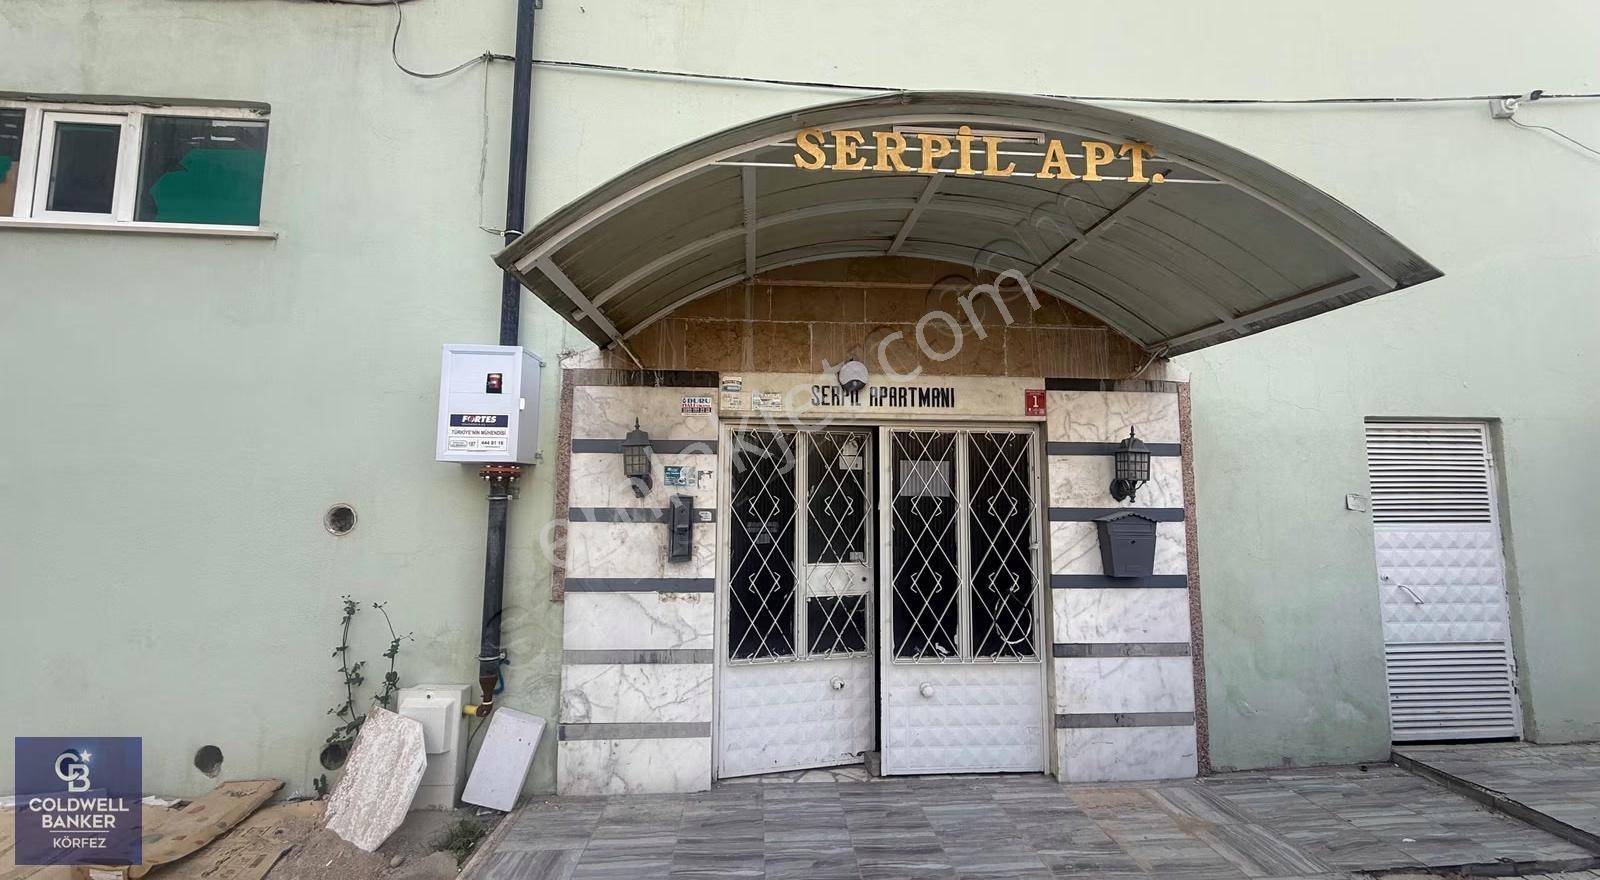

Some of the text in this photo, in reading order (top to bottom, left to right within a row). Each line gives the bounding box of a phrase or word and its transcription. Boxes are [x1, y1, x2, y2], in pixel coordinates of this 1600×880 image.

[794, 126, 1165, 184] SERPİL APT.
[870, 386, 955, 408] APARTMANI
[1032, 395, 1039, 408] 1
[462, 415, 497, 423] FORTES
